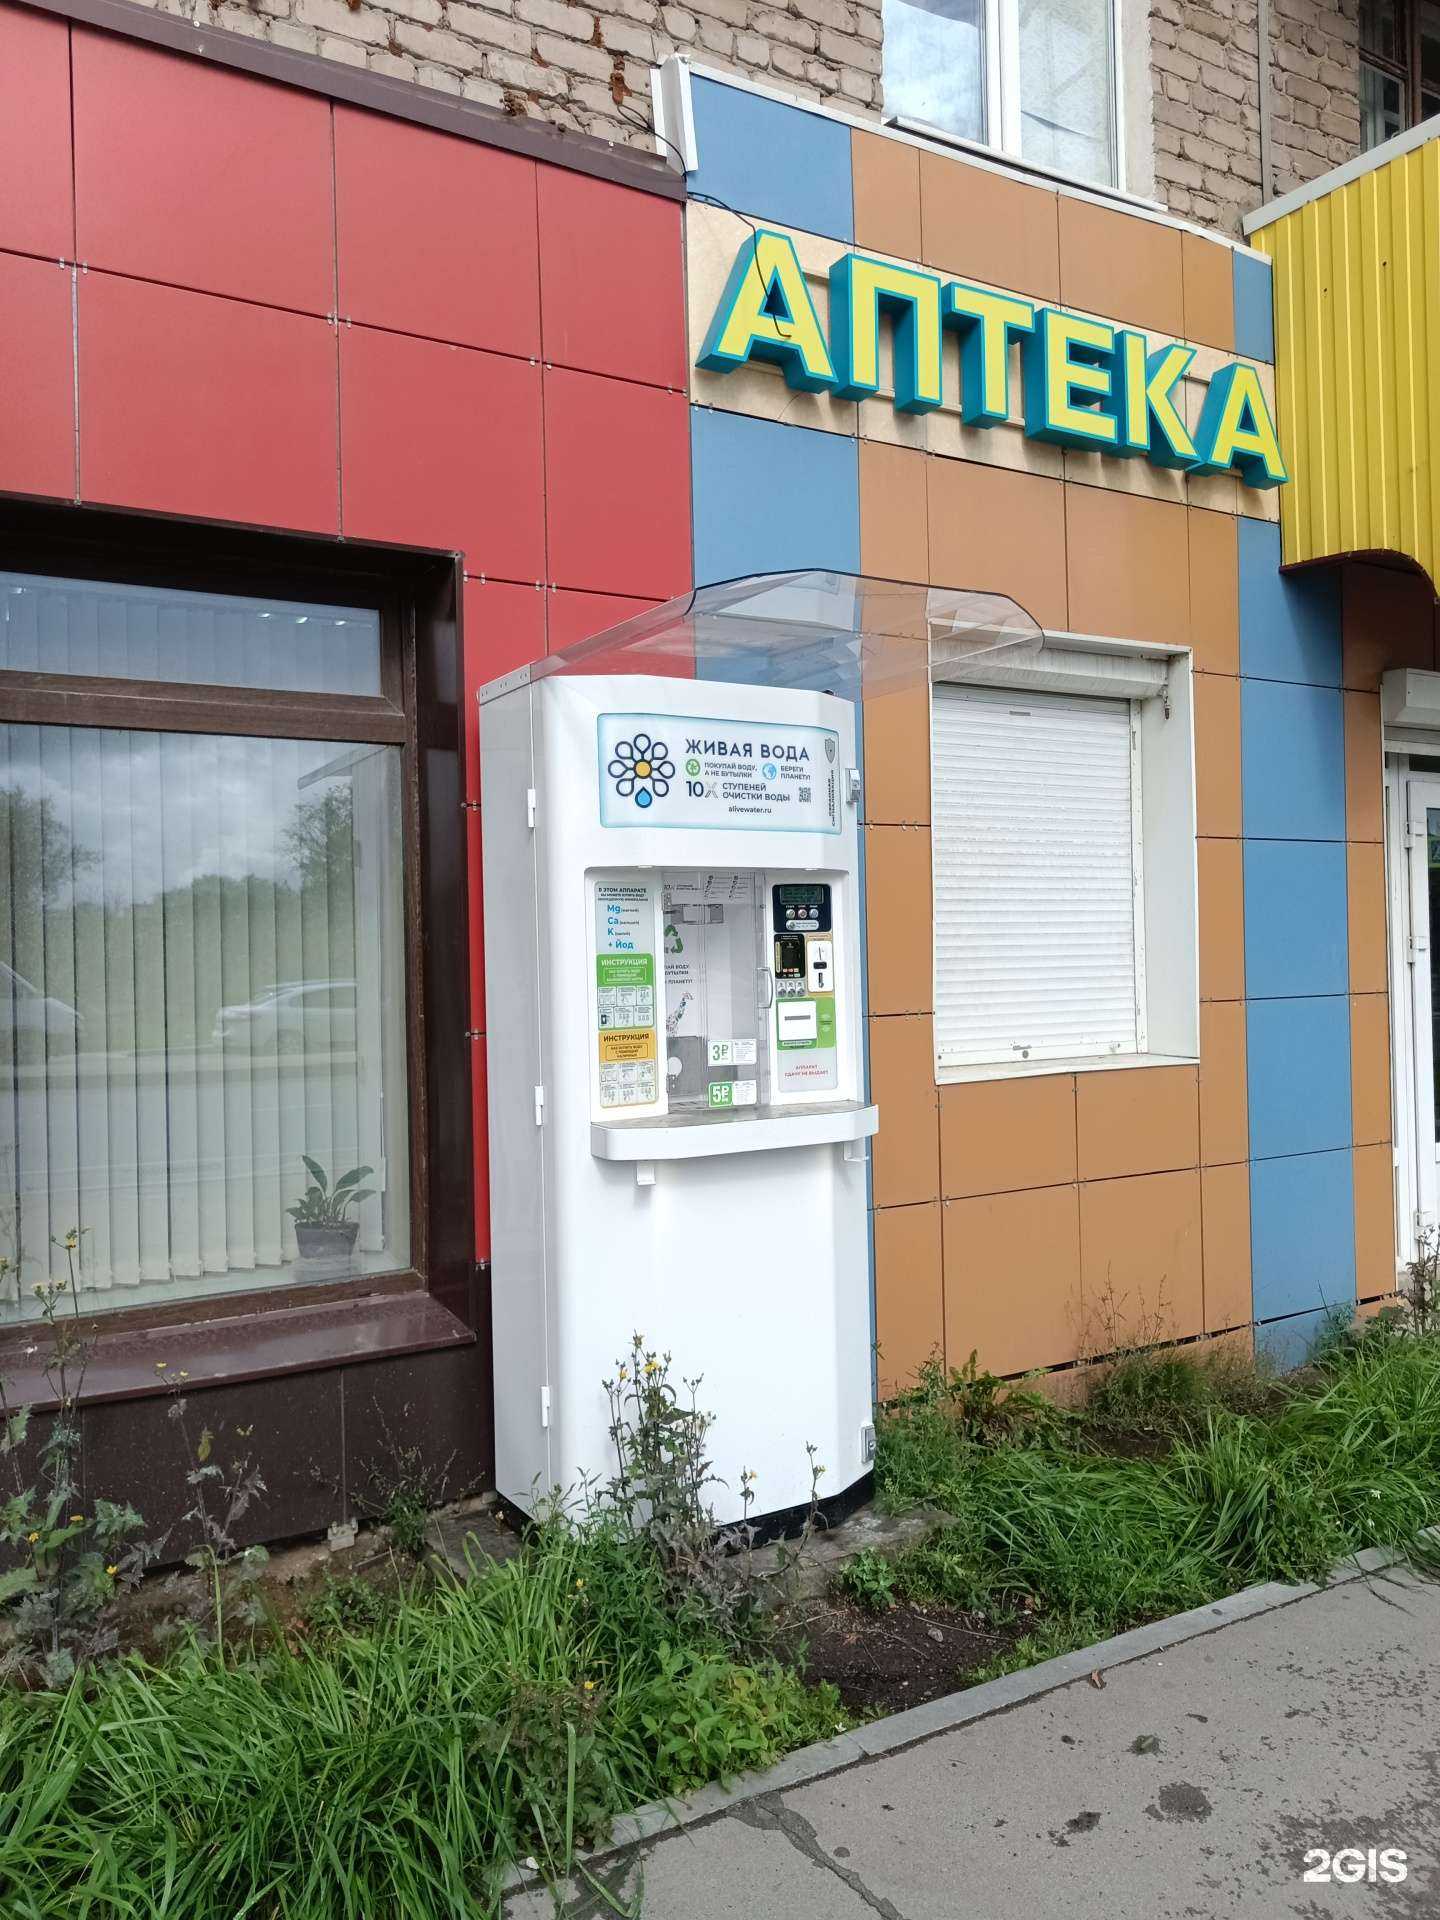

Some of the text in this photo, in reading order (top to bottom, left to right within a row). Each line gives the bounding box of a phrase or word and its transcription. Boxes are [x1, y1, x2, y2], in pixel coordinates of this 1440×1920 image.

[695, 228, 1288, 490] АПТЕКА
[685, 739, 810, 762] ЖИВАЯ ВОДА
[704, 762, 758, 772] ПОКУПАЙ ВОДУ,
[721, 770, 753, 778] БУТЫЛКИ
[722, 782, 767, 791] СТУПЕНЕЙ
[722, 791, 791, 802] ОЧИСТКИ ВОДЫ
[728, 805, 772, 814] alivewater.ru
[607, 904, 621, 914] Mg
[607, 916, 619, 925] Ca
[615, 938, 634, 949] Йод
[603, 1033, 650, 1042] ИНСТРУКЦИЯ
